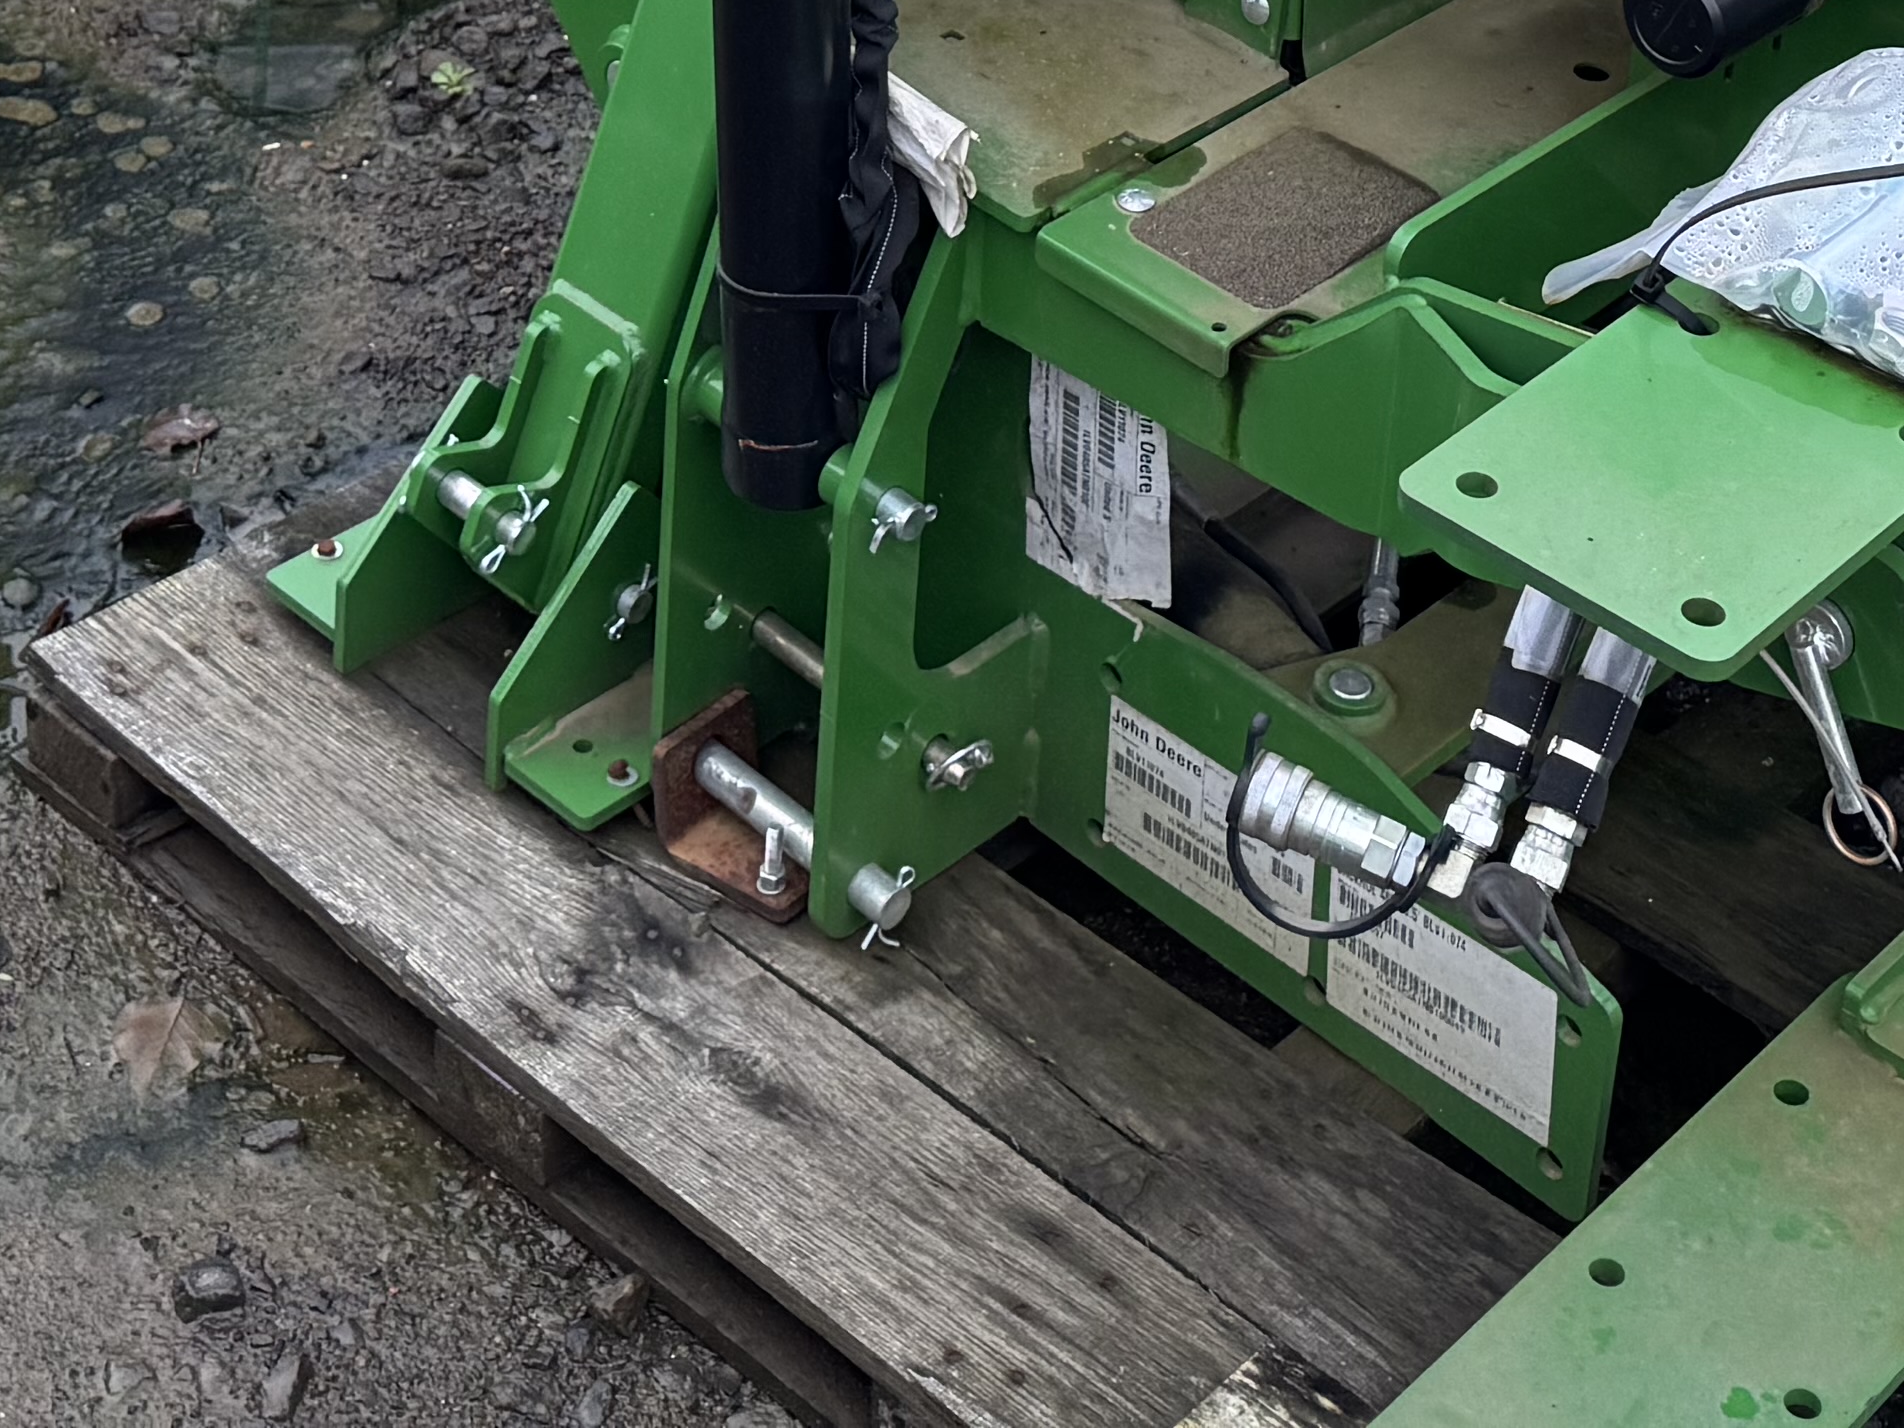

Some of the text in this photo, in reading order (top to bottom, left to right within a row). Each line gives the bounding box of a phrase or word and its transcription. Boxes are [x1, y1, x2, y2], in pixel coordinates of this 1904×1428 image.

[1139, 440, 1157, 495] Deere
[1111, 708, 1149, 744] John
[1155, 735, 1203, 778] Deere
